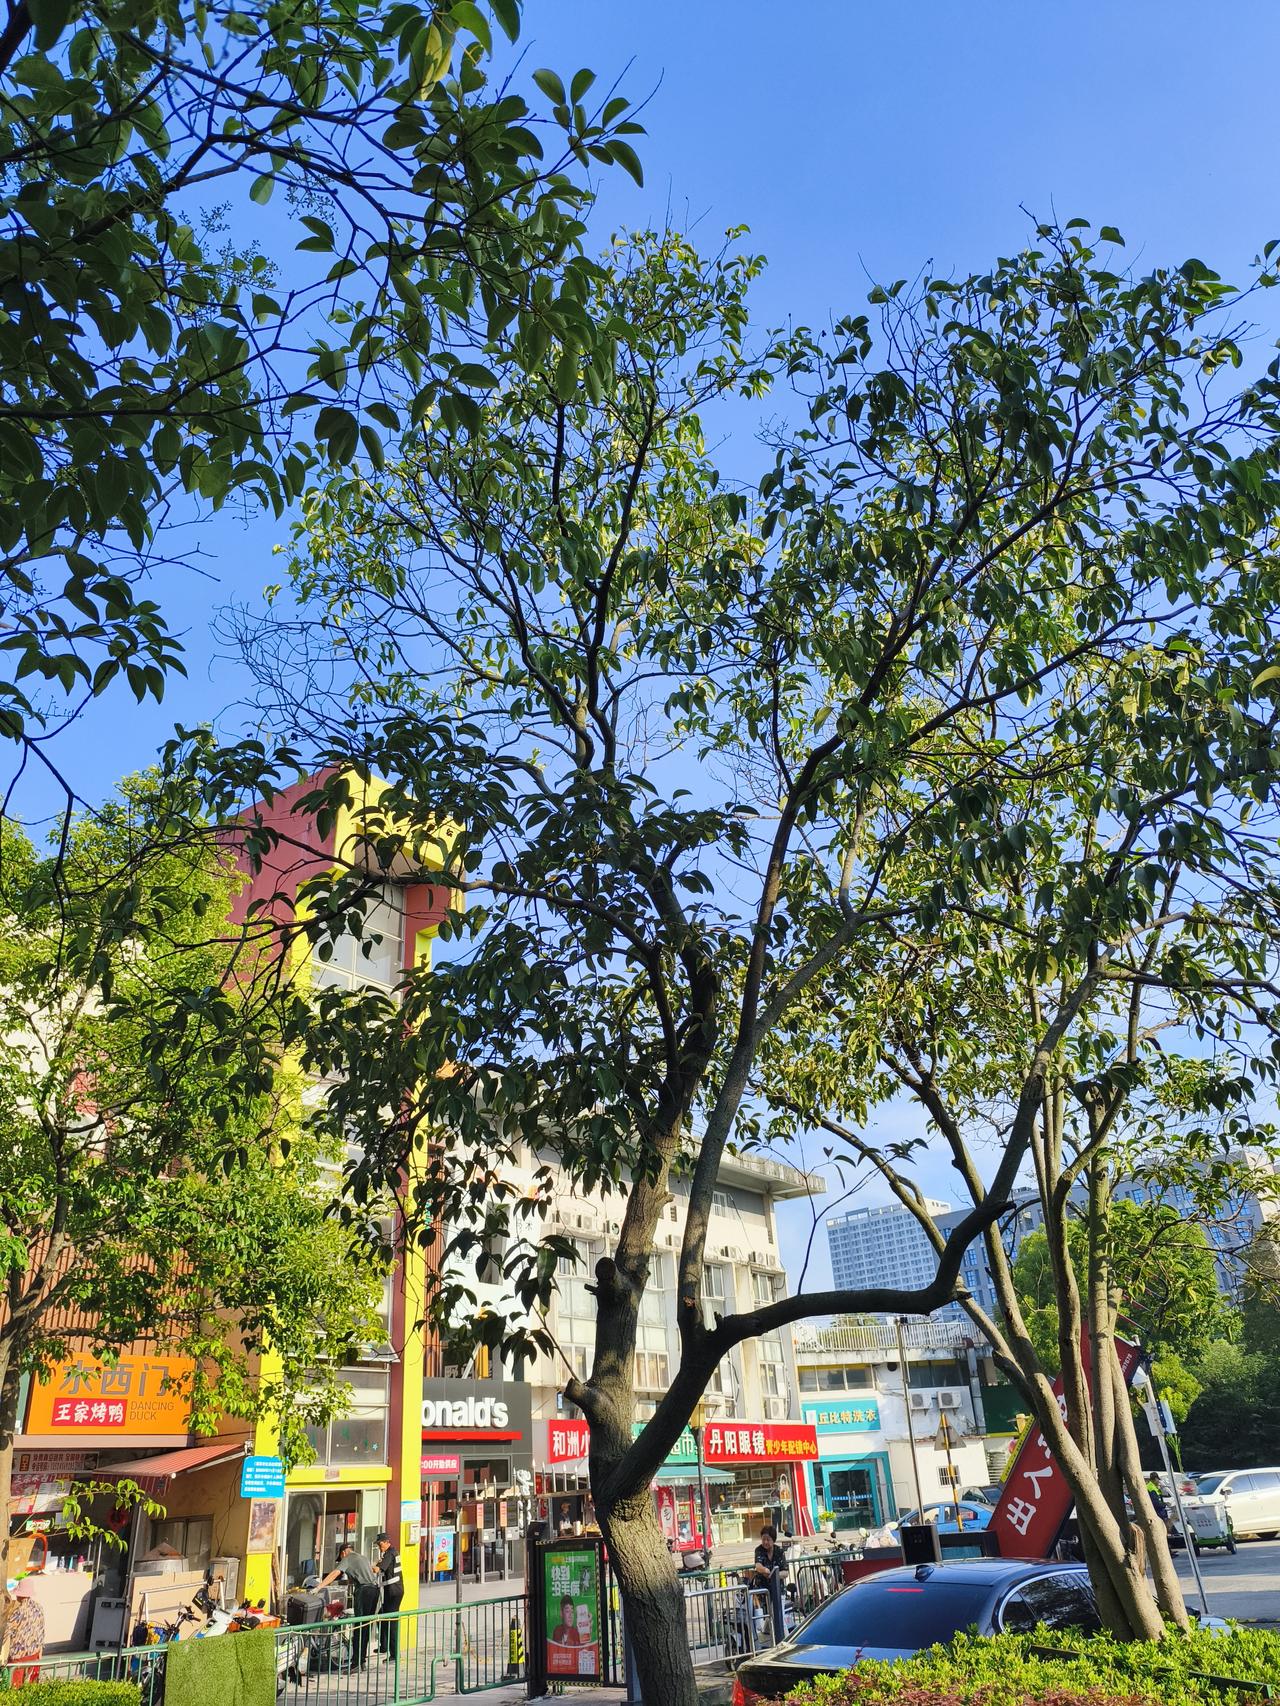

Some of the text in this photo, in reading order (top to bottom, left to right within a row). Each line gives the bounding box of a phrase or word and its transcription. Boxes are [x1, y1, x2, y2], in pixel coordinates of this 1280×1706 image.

[59, 1360, 170, 1397] 水西门
[54, 1401, 124, 1424] 王家烤鸭
[131, 1401, 175, 1411] DANCING
[129, 1411, 157, 1421] DUCK
[818, 1409, 877, 1425] 丘比特洗衣
[709, 1428, 817, 1456] 丹阳眼镜 青少年配镜中心
